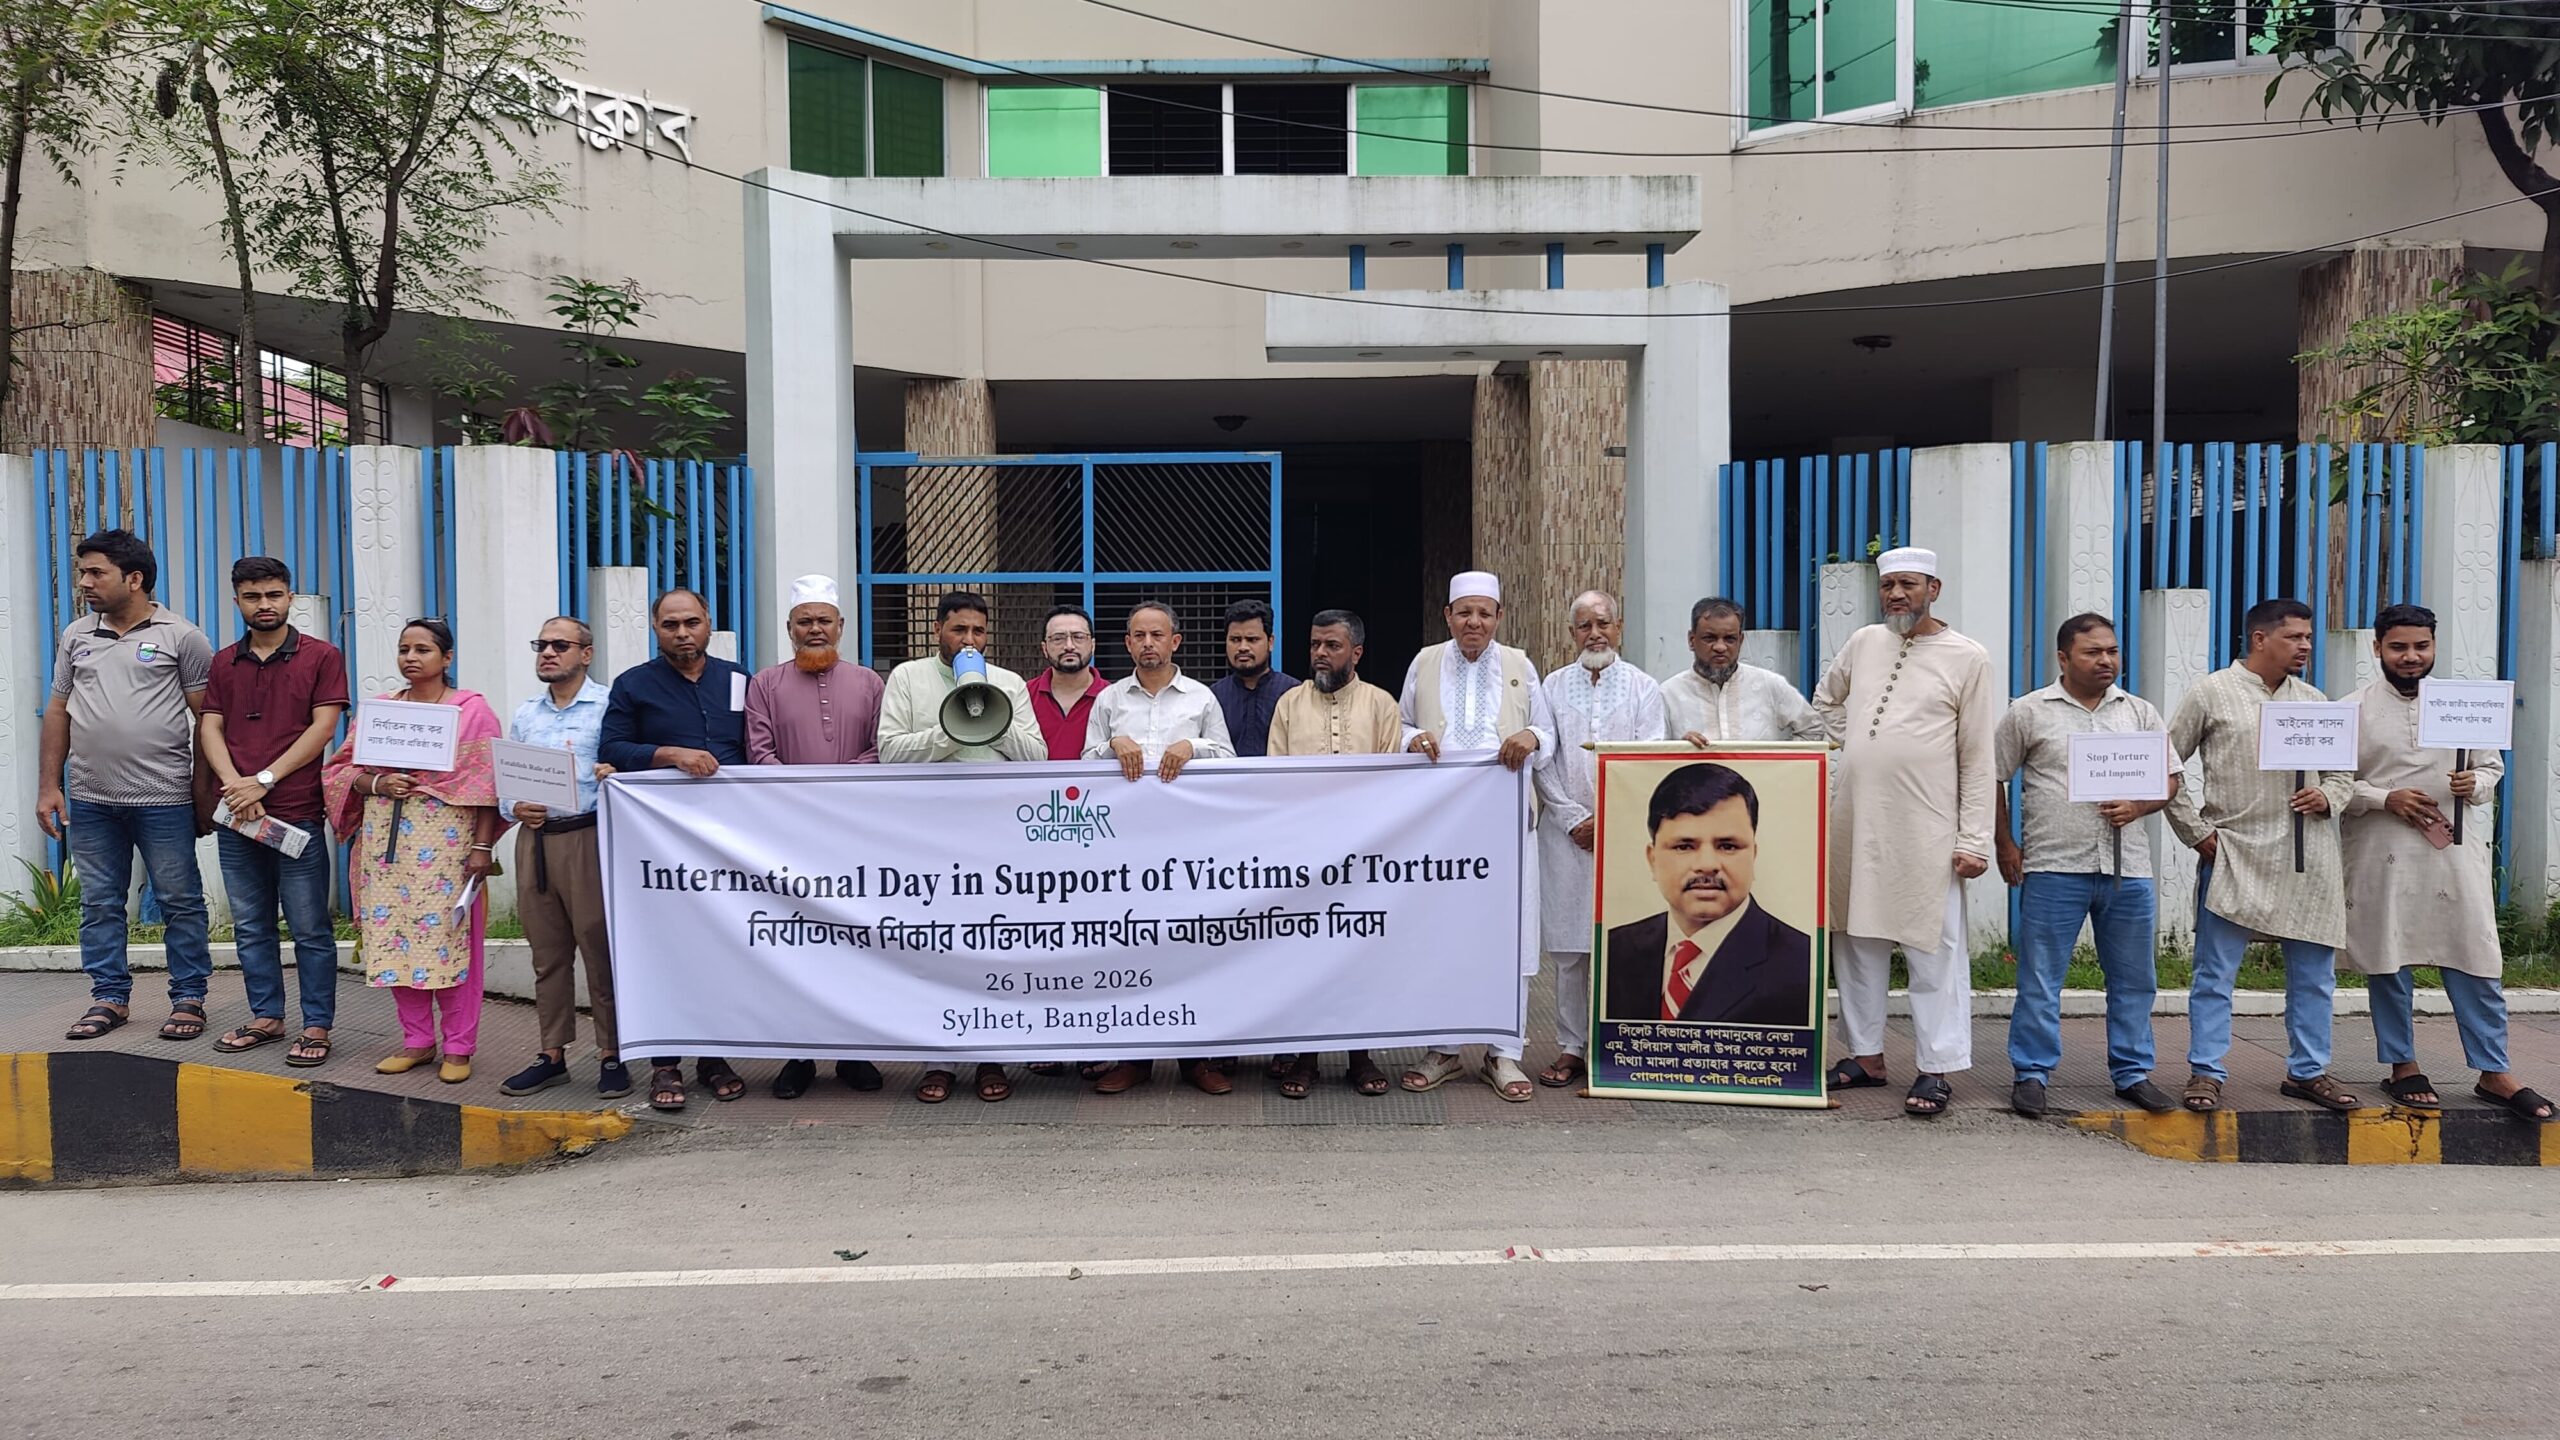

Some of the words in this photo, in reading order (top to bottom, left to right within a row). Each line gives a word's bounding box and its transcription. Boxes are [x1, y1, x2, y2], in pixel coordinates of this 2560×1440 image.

[372, 718, 407, 731] নির্যাতন
[428, 725, 443, 734] কর
[2276, 715, 2314, 729] আইনের
[2318, 718, 2344, 729] শাসন
[2440, 714, 2463, 723] কমিশন
[2318, 736, 2334, 746] কর
[2086, 751, 2108, 763] Stop
[2111, 751, 2149, 762] Torture
[2089, 769, 2106, 777] End
[2108, 768, 2146, 778] Impunity
[640, 859, 866, 898] International
[879, 867, 941, 906] Day
[951, 863, 984, 897] in
[995, 862, 1132, 903] Support
[1142, 858, 1177, 892] of
[1182, 856, 1310, 891] Victims
[1320, 854, 1356, 887] of
[1363, 852, 1489, 884] Torture
[748, 911, 871, 949] নির্যাতনের
[877, 916, 955, 953] শিকার
[961, 914, 1066, 952] ব্যক্তিদের
[1071, 909, 1160, 948] সমর্থনে
[1166, 906, 1320, 947] আন্তর্জাতিক
[1326, 903, 1387, 938] দিবস
[985, 973, 1015, 992] 26
[1022, 973, 1085, 995] June
[1094, 969, 1153, 990] 2026
[942, 1007, 1034, 1037] Sylhet,
[1044, 1004, 1197, 1034] Bangladesh
[1618, 1024, 1652, 1036] সিলেট
[1656, 1025, 1701, 1039] বিভাগের
[1705, 1028, 1762, 1042] গণমানুষের
[1766, 1032, 1794, 1043] নেতা
[1631, 1039, 1672, 1054] ইলিয়াস
[1675, 1040, 1710, 1055] আলীর
[1714, 1042, 1741, 1056] উপর
[1745, 1045, 1775, 1056] থেকে
[1778, 1047, 1807, 1058] সকল
[1614, 1053, 1642, 1067] মিথ্যা
[1646, 1057, 1679, 1068] মামলা
[1682, 1058, 1729, 1070] প্রত্যাহার
[1732, 1060, 1766, 1072] করতে
[1770, 1061, 1797, 1073] হবে!
[1630, 1071, 1695, 1084] গোলাপগঞ্জ
[1700, 1072, 1729, 1086] পৌর
[1733, 1073, 1782, 1087] বিএনপি
